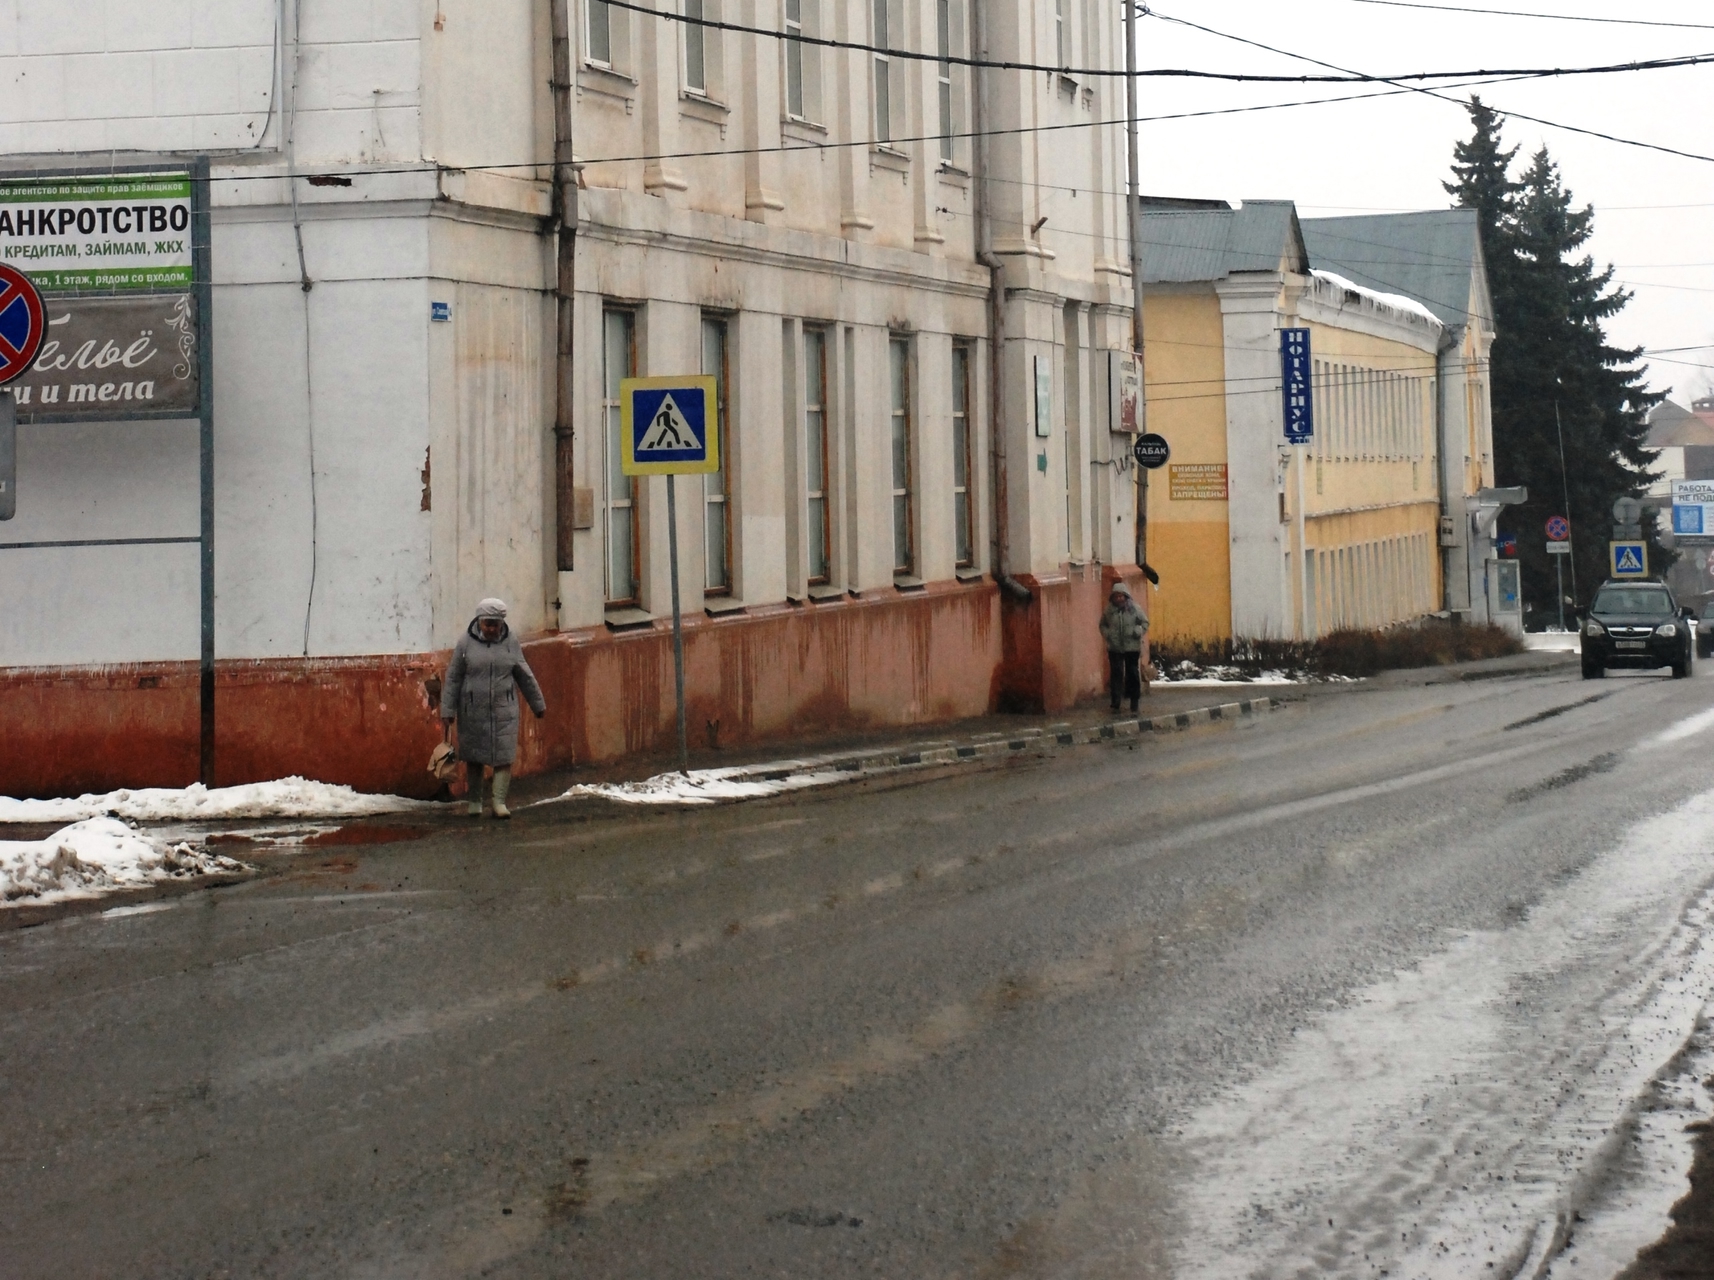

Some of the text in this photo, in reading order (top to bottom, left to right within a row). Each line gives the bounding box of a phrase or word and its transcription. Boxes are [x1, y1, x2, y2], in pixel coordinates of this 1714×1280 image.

[12, 186, 58, 196] агентство
[60, 186, 70, 194] по
[72, 185, 105, 195] защите
[107, 184, 130, 194] прав
[131, 182, 184, 193] заёмщиков
[0, 205, 189, 237] АНКРОТСТВО
[5, 240, 184, 260] КРЕДИТАМ, ЗАЙМАМ, ЖКХ
[55, 275, 61, 285] 1
[63, 275, 93, 286] этаж,
[95, 274, 129, 286] рядом
[131, 274, 144, 283] со
[146, 273, 188, 283] входом.
[33, 313, 158, 371] ельё
[1288, 332, 1306, 432] НОТАРИУС
[40, 384, 60, 404] и
[67, 380, 155, 403] тела
[1136, 447, 1167, 455] ТАБАК
[1172, 491, 1227, 499] ЗАПРЕЩЕНЫ!
[1678, 494, 1691, 502] НЕ
